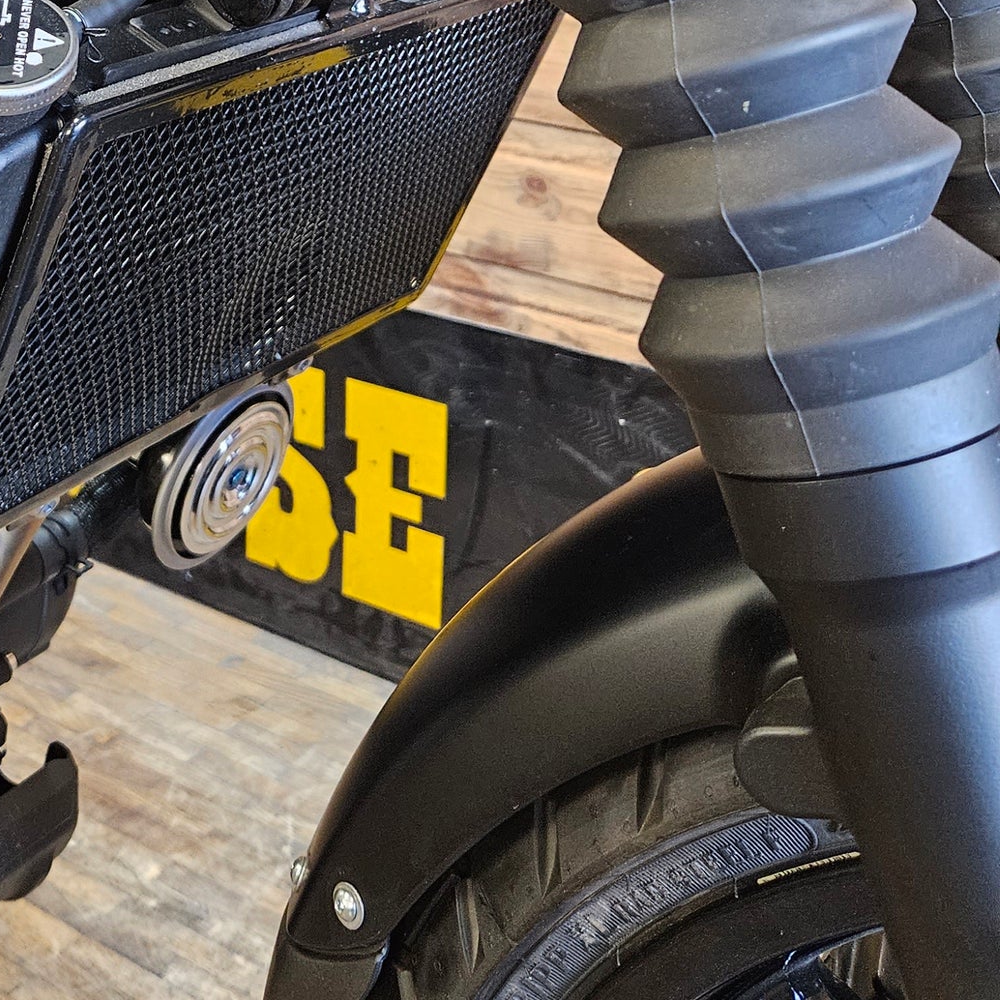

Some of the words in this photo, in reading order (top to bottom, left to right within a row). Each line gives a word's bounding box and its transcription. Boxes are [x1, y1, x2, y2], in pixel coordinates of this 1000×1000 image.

[18, 0, 34, 29] NEVER
[14, 30, 29, 58] OPEN
[11, 57, 26, 78] HOT
